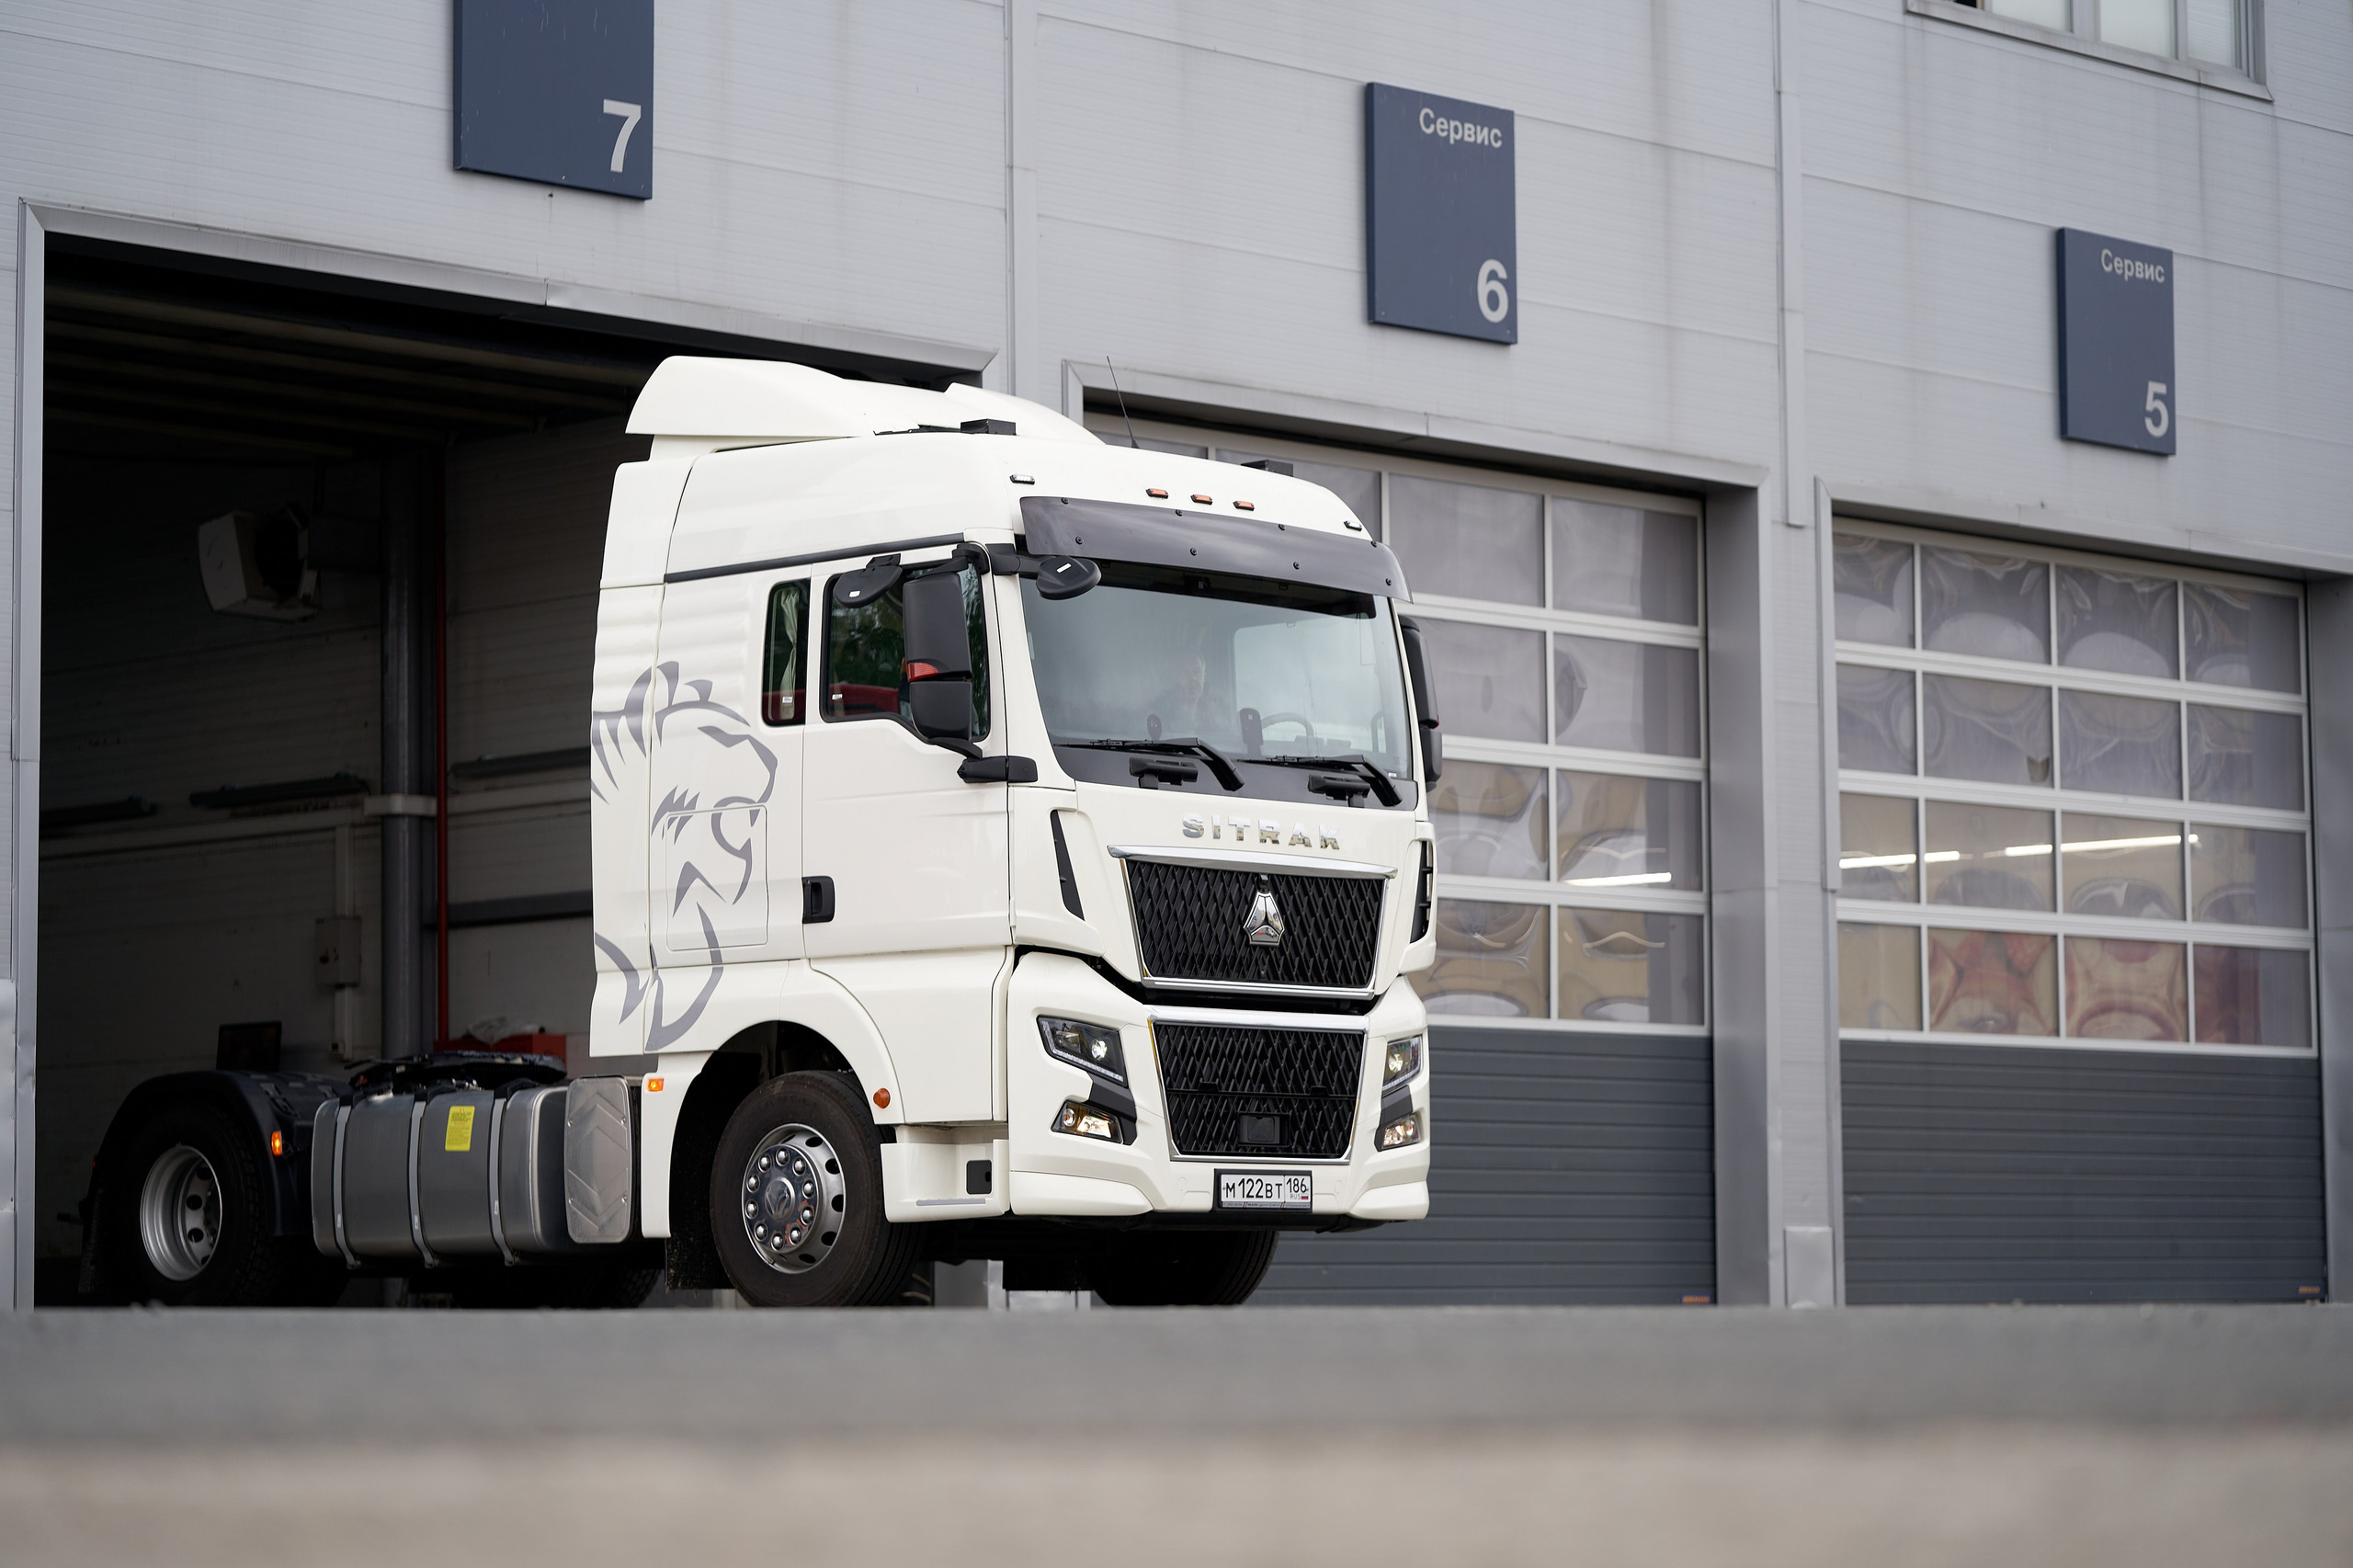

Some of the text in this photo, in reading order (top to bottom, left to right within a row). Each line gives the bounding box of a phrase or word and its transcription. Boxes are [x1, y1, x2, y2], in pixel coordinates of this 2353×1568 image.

[603, 98, 642, 173] 7
[1418, 108, 1503, 148] Сервис
[2100, 248, 2165, 284] Сервис
[1477, 258, 1509, 323] 6
[2144, 380, 2169, 438] 5
[1182, 813, 1340, 850] SITRAK
[1286, 1177, 1307, 1194] 186
